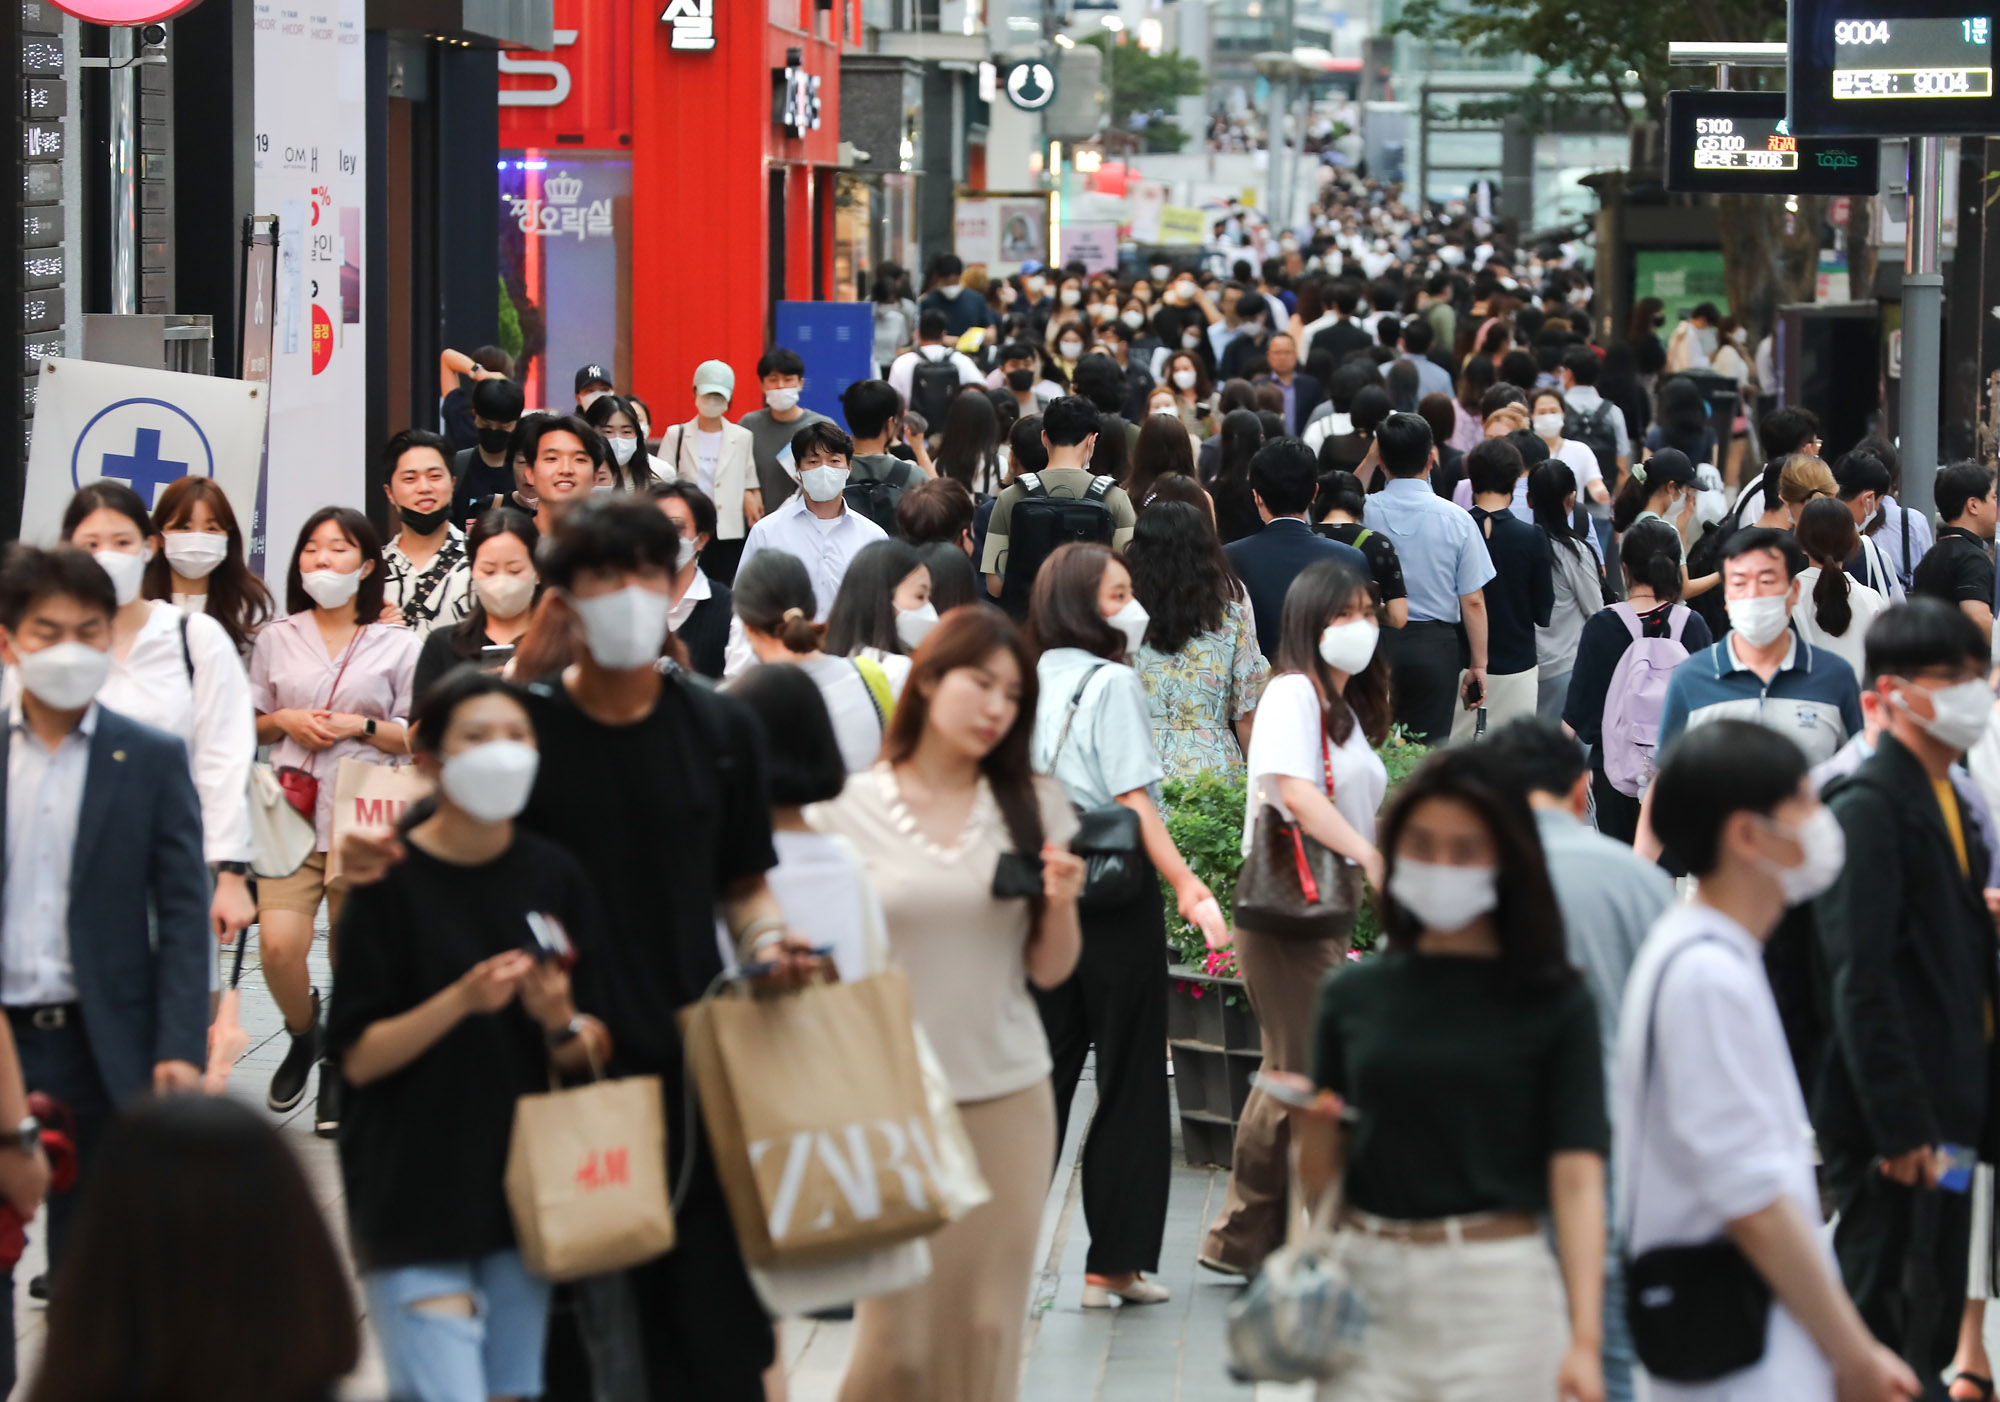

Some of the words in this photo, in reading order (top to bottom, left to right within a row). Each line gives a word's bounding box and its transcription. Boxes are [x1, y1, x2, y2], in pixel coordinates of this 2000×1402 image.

[1835, 20, 1890, 45] 9004
[1961, 17, 1988, 45] 1분
[1913, 71, 1969, 94] 9004
[1696, 118, 1733, 134] 5100
[256, 134, 269, 152] 19
[1696, 135, 1745, 151] G5100
[340, 149, 356, 175] ley
[1746, 153, 1783, 168] 5006
